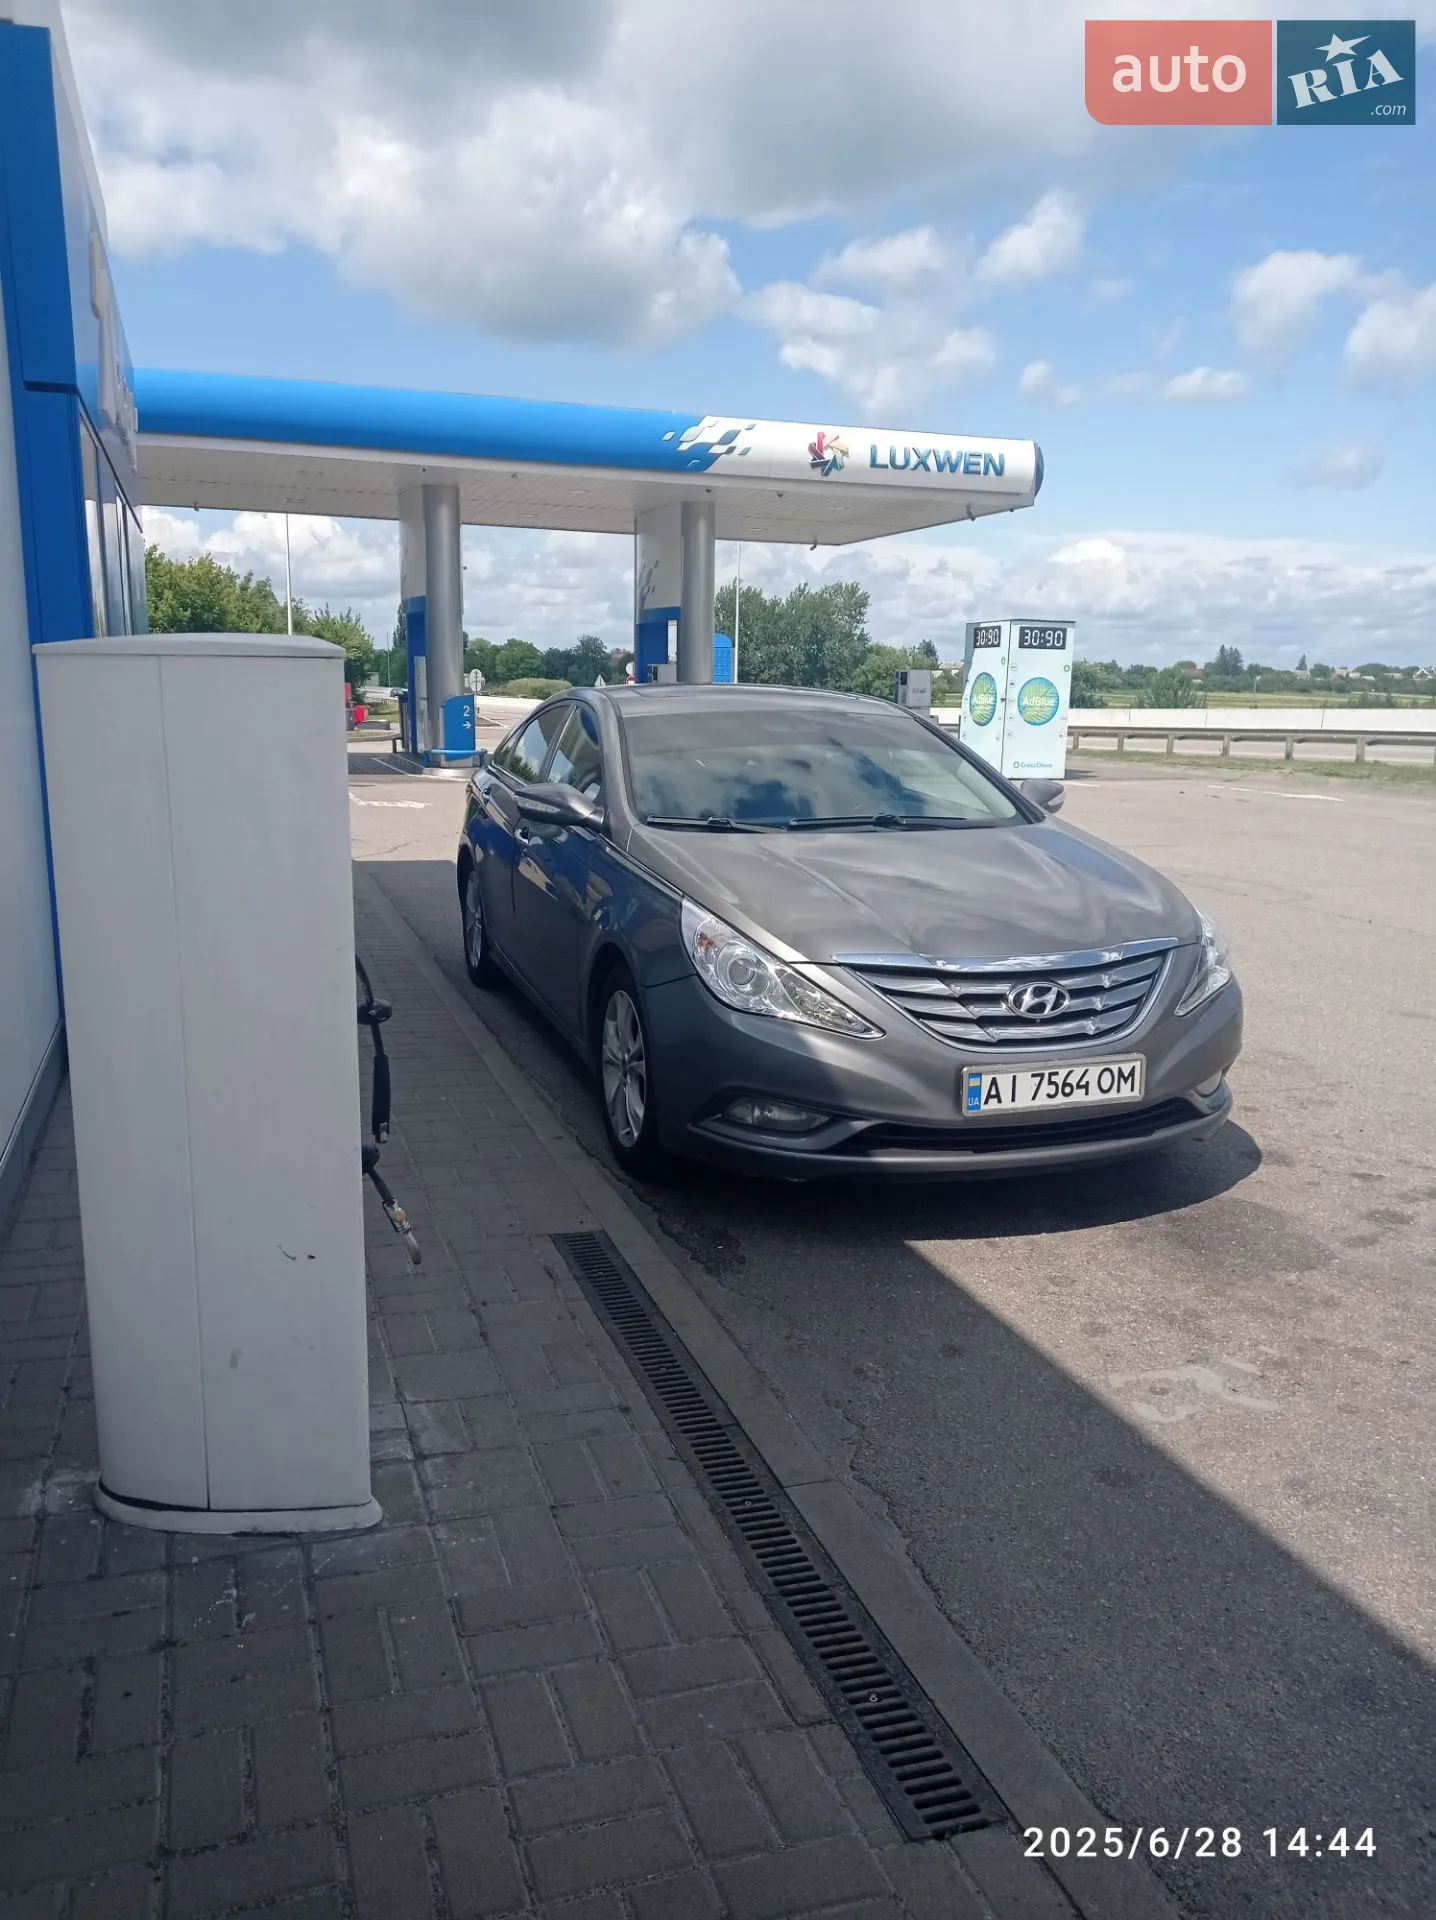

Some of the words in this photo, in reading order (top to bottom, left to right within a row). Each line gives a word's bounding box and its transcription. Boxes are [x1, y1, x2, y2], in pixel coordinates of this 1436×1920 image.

[870, 444, 1005, 476] LUXWEN
[1022, 695, 1055, 707] AdBlue
[463, 705, 470, 716] 2
[1030, 1068, 1090, 1101] 7564
[1097, 1065, 1136, 1095] OM
[968, 1097, 980, 1107] UA
